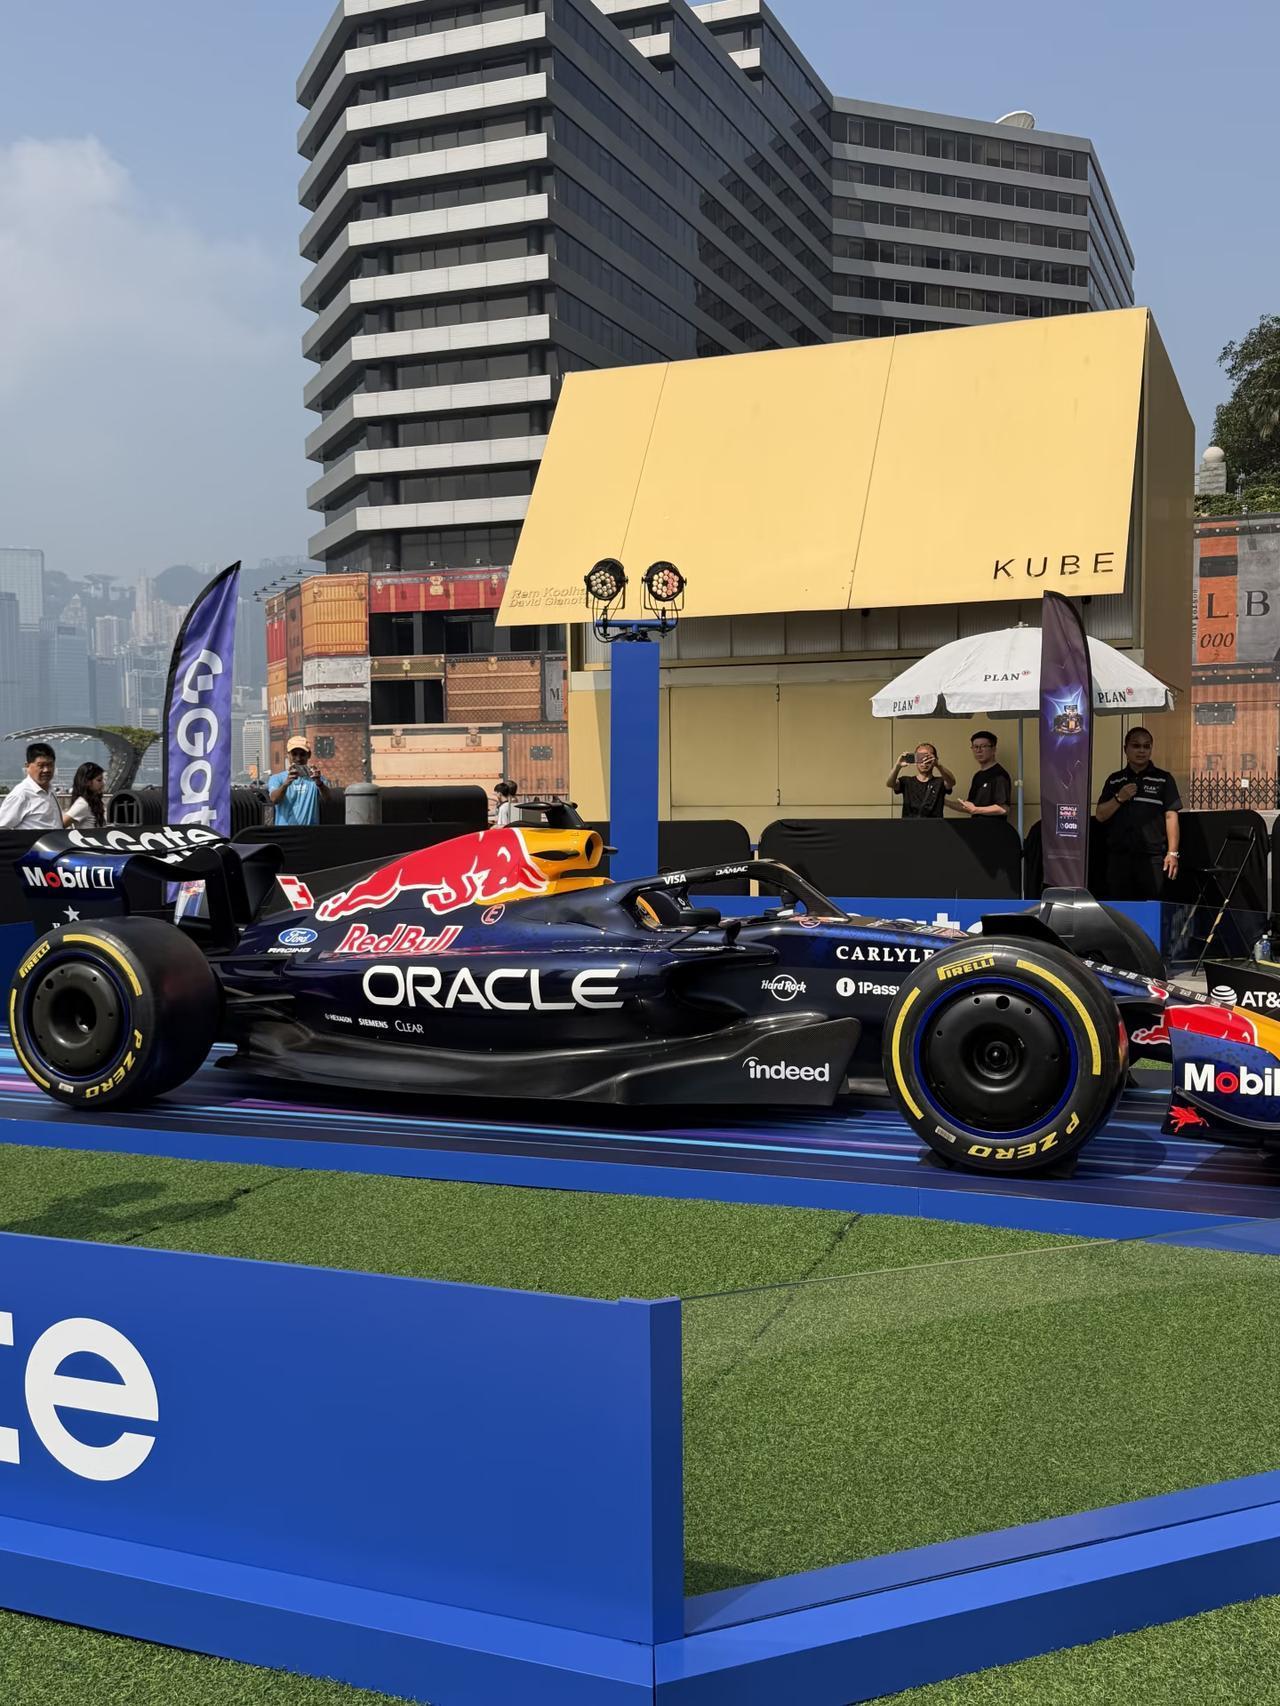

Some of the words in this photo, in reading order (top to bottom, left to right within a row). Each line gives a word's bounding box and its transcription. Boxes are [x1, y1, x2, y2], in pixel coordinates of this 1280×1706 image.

[993, 552, 1114, 580] KUBE
[509, 599, 541, 608] David
[984, 673, 1020, 682] PLAN
[893, 699, 914, 712] PLAN
[1097, 690, 1127, 704] PLAN
[177, 708, 218, 826] Gat
[22, 866, 89, 888] Mobil
[663, 874, 687, 885] VISA
[715, 866, 748, 875] DAMAC
[18, 940, 50, 979] PIRELLI
[937, 953, 995, 981] PIRELLI
[362, 965, 624, 1011] ORACLE
[858, 981, 899, 996] 1Pass
[1241, 990, 1280, 1009] AT&
[328, 1014, 352, 1024] HEXAGON
[358, 1018, 389, 1029] SIEMENS
[133, 1029, 143, 1049] P
[85, 1051, 137, 1099] ZERO
[748, 1059, 830, 1082] indeed
[1064, 1111, 1080, 1135] P
[966, 1134, 1059, 1160] ZERO
